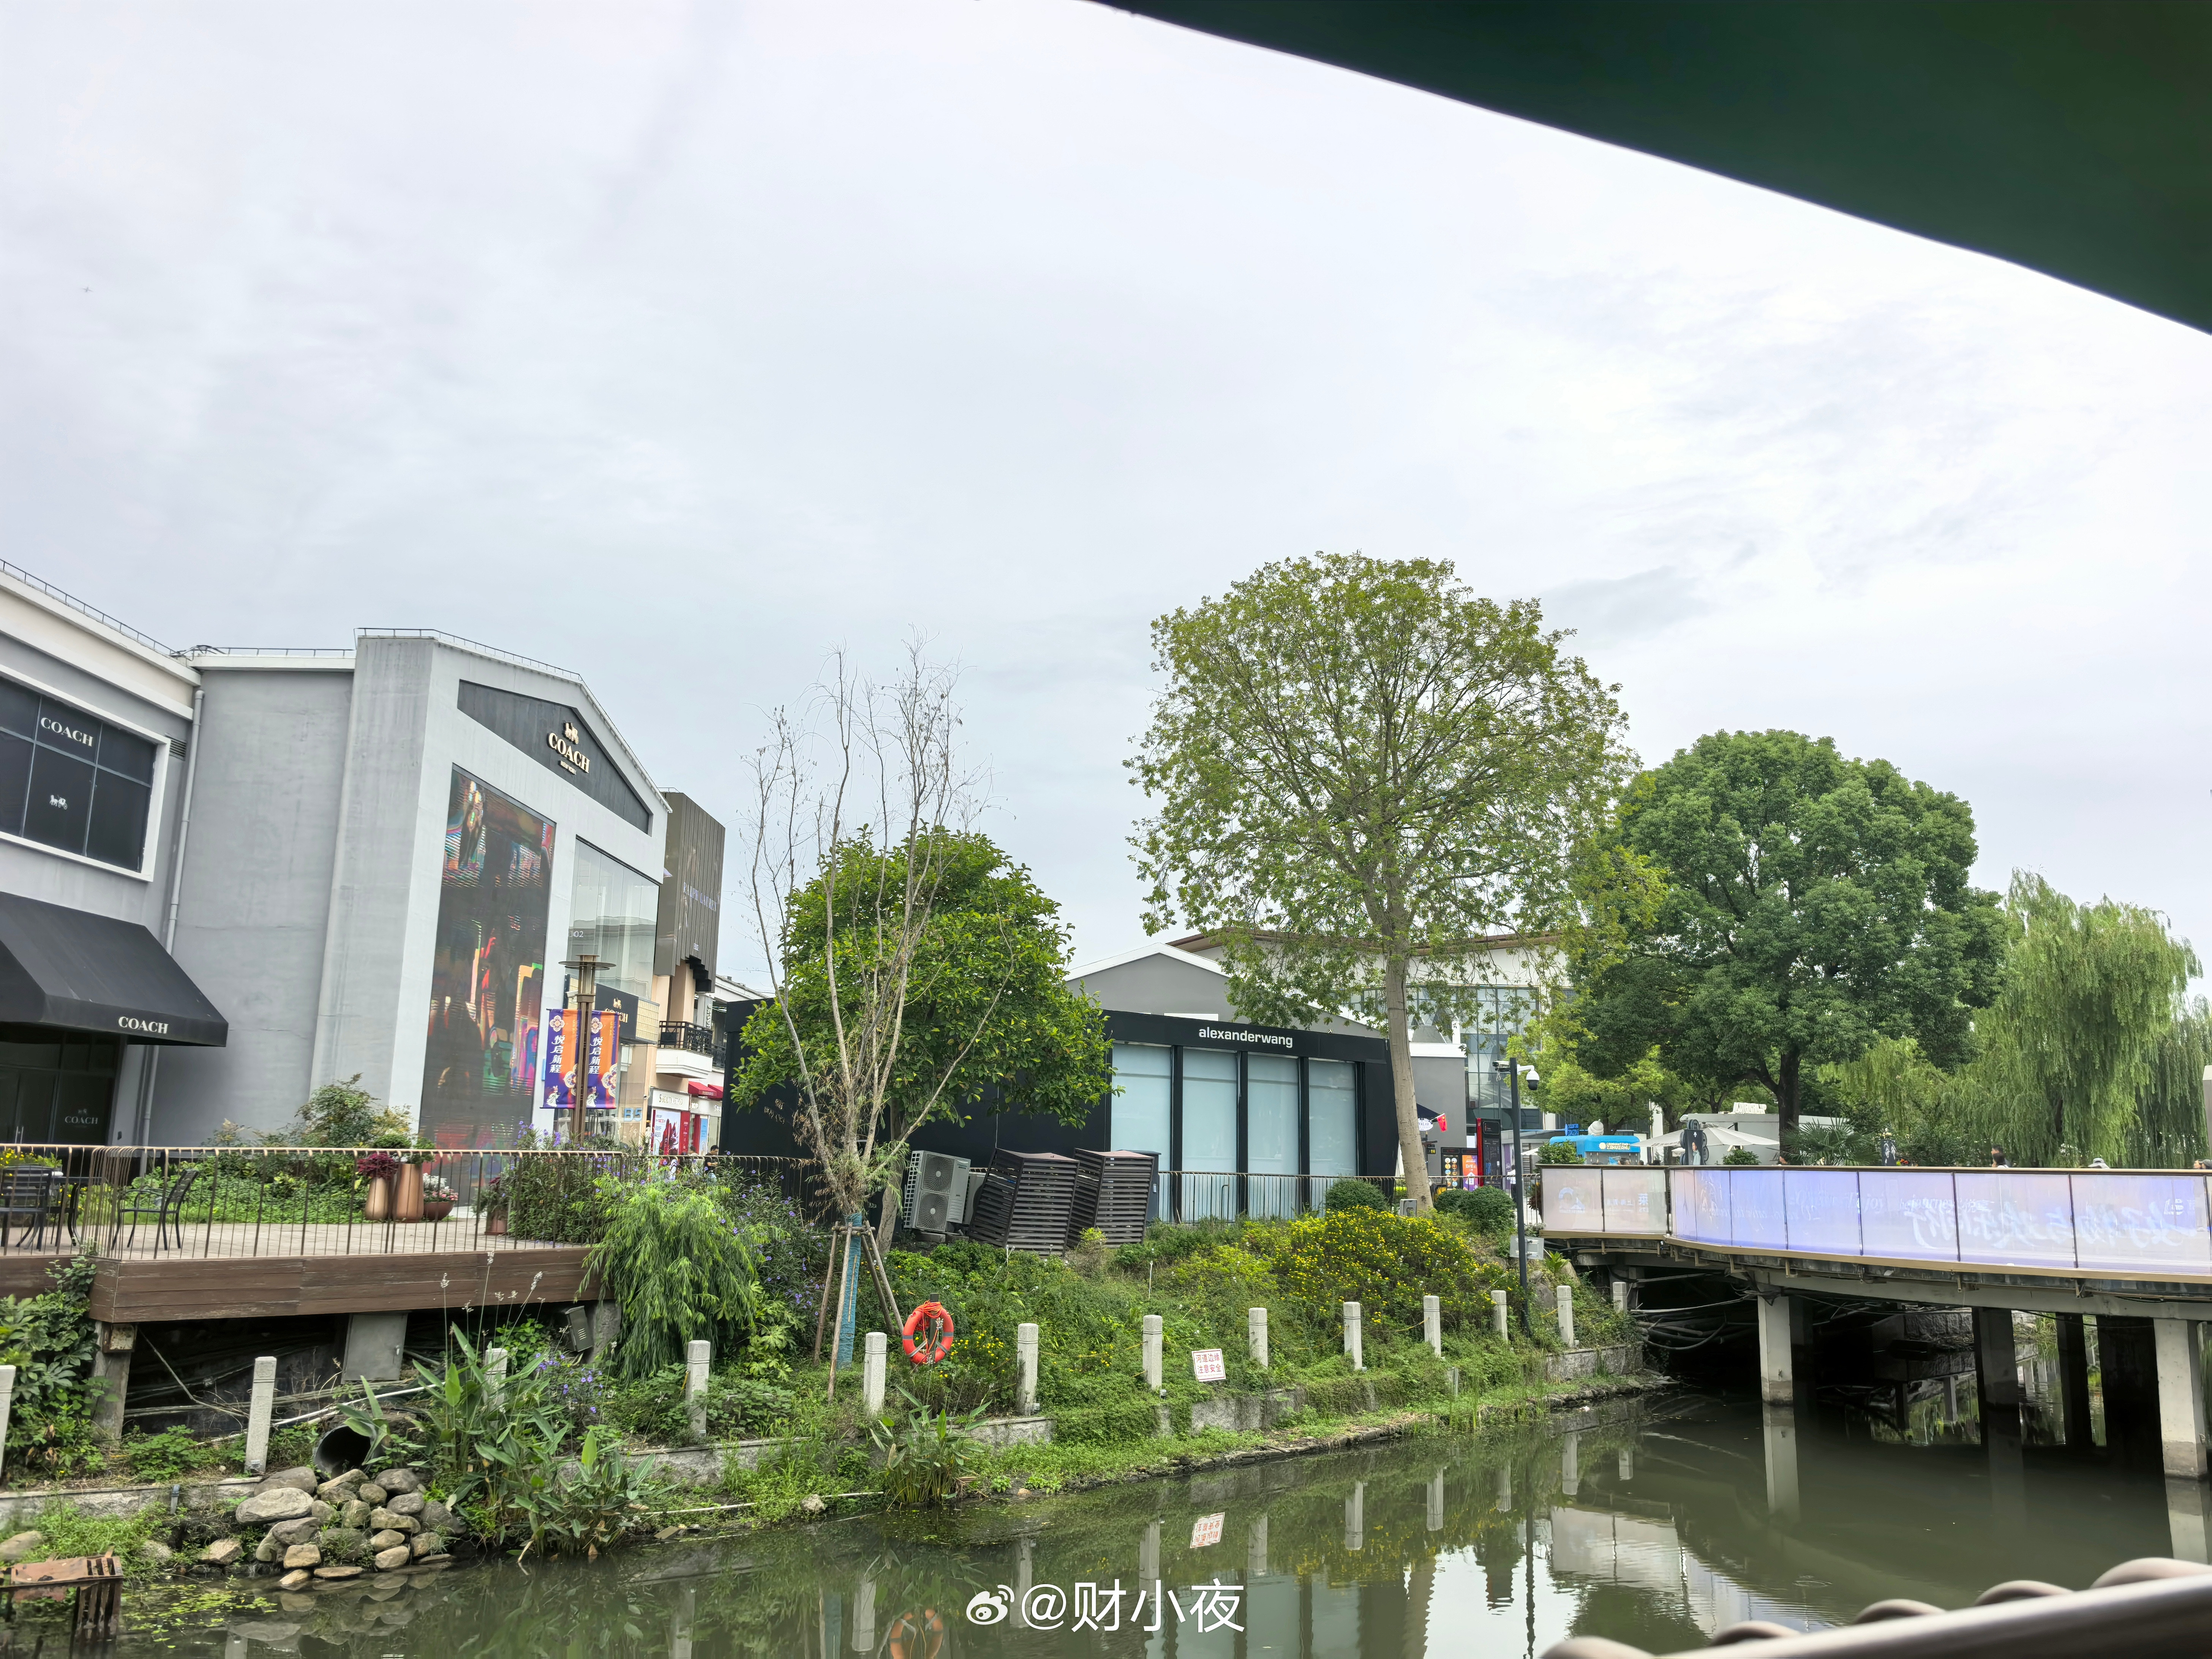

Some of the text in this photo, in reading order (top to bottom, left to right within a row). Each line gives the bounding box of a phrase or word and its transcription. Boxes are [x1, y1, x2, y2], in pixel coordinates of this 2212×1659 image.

[41, 717, 94, 747] COACH
[548, 732, 590, 773] COACH
[683, 882, 717, 912] RALPH LAUREN
[118, 1016, 169, 1034] COACH
[1199, 1027, 1293, 1048] alexanderwang
[549, 1035, 566, 1073] 悦启新程
[588, 1036, 604, 1074] 悦启新程
[65, 1115, 98, 1125] COACH
[624, 1108, 643, 1122] B5
[1196, 1353, 1220, 1363] 河道边缘
[1198, 1363, 1221, 1374] 注意安全
